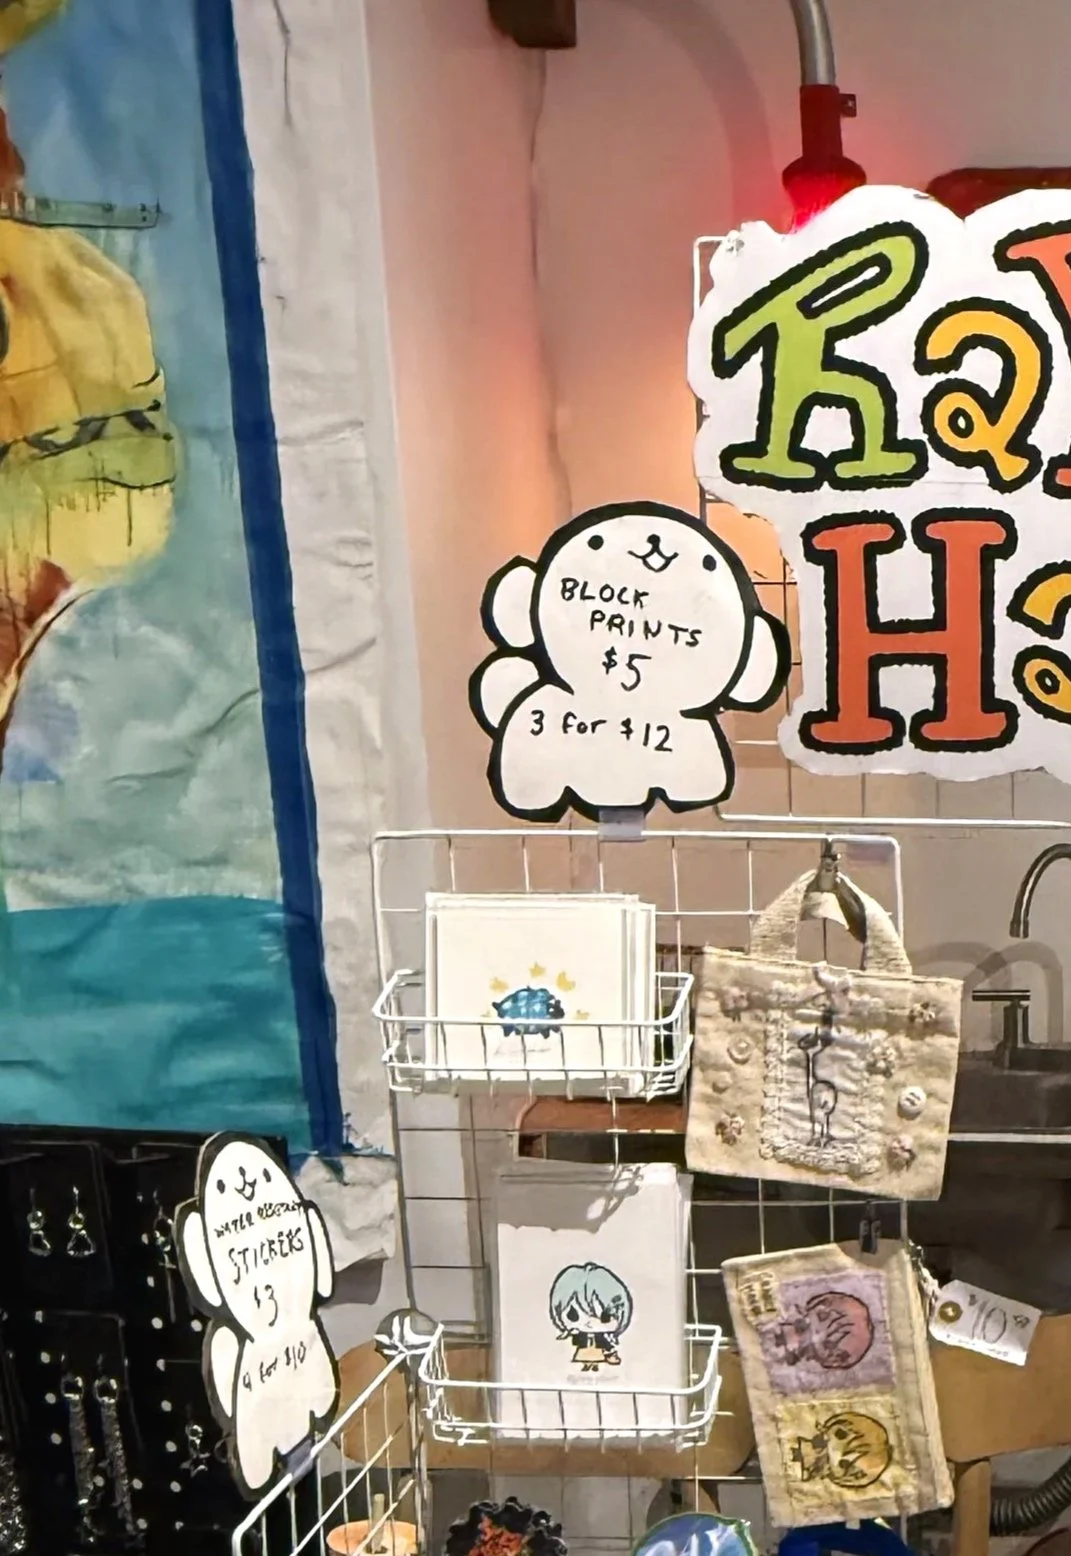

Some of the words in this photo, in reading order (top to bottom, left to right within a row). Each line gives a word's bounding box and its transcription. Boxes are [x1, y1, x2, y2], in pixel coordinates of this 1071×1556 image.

[561, 577, 649, 609] BLOCK
[590, 610, 702, 647] PRINTS
[602, 646, 652, 691] $5
[530, 710, 545, 736] 3
[562, 711, 607, 734] for
[620, 718, 673, 752] $12
